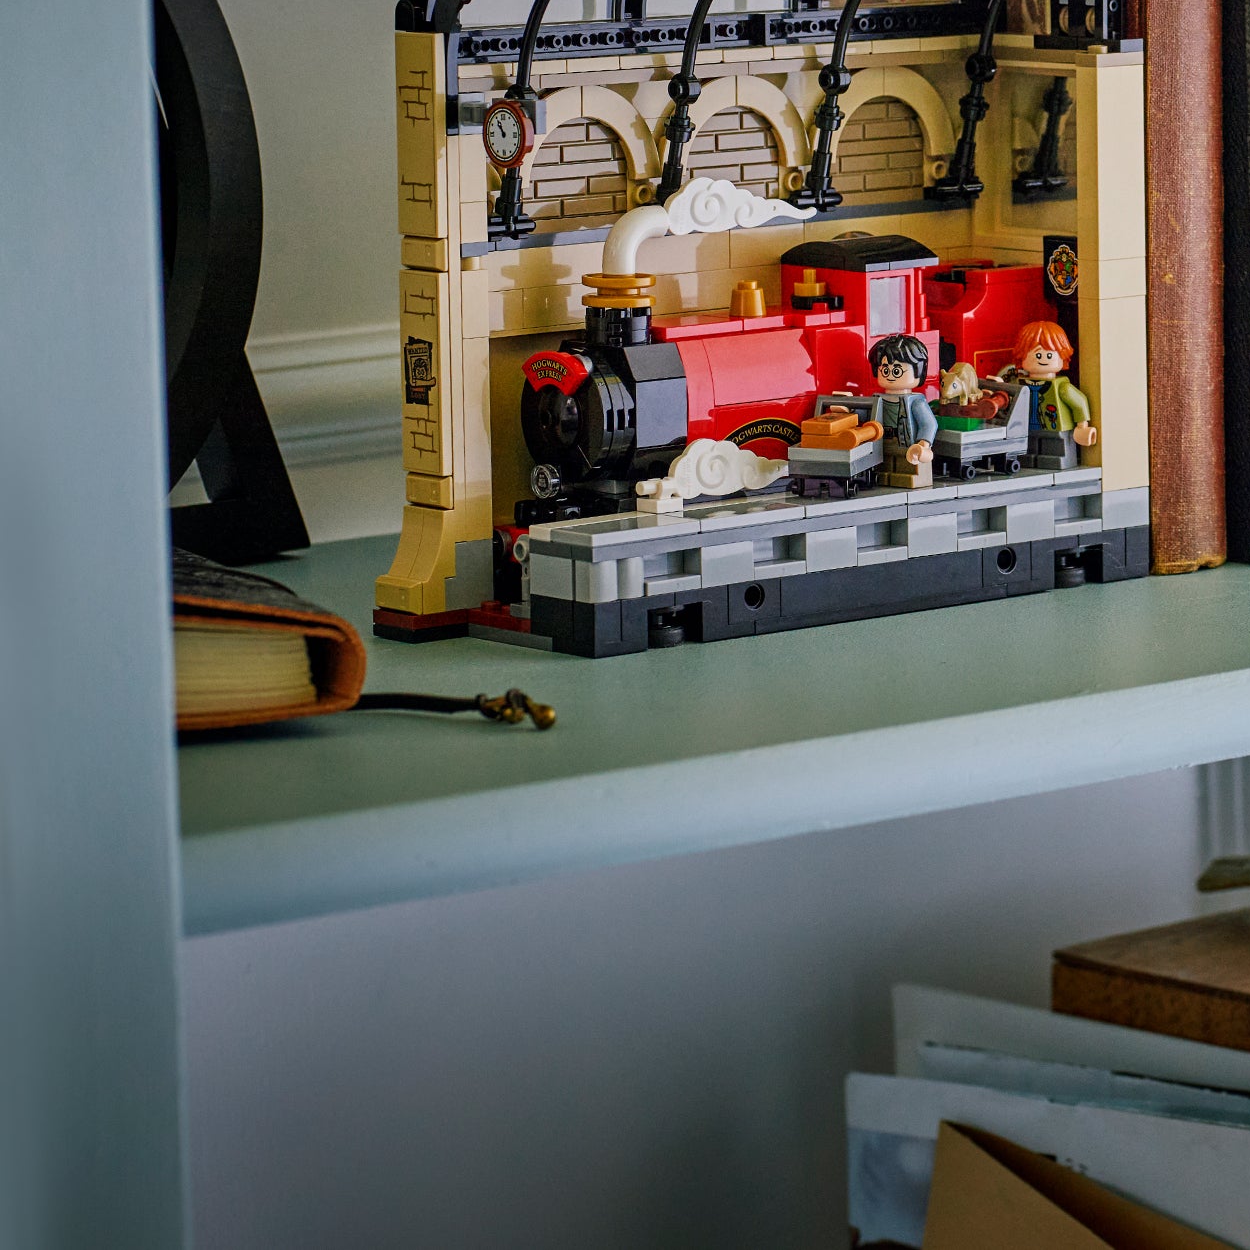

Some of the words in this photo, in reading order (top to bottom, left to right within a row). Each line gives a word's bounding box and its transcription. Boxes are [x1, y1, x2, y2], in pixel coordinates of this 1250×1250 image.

[531, 359, 568, 376] HOGWARTS
[537, 370, 562, 382] EXPRESS
[731, 424, 772, 444] OGWARTS
[772, 424, 800, 441] CASTLE
